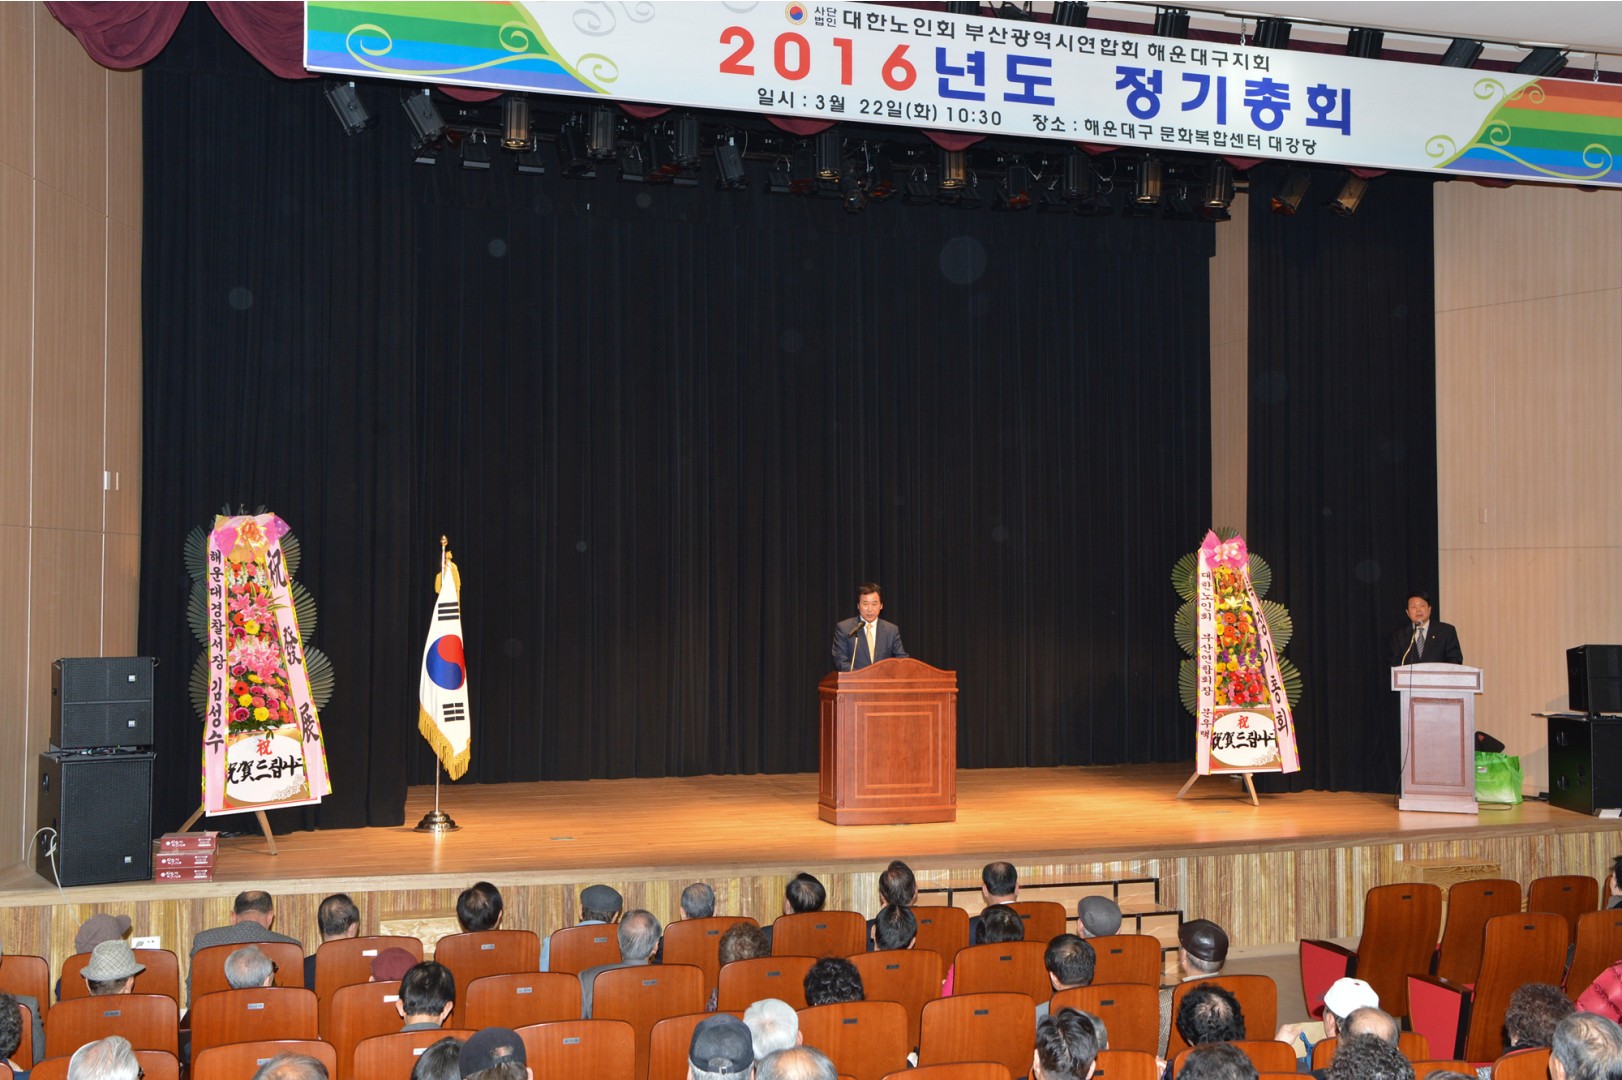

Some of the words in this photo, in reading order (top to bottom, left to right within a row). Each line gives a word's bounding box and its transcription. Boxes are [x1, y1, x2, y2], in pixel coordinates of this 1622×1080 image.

[814, 6, 837, 17] 사단
[814, 16, 836, 28] 법인
[843, 10, 956, 40] 대한노인회
[966, 23, 1138, 59] 부산광역시연합회
[1147, 42, 1270, 72] 해운대구지회
[719, 26, 1055, 107] 2016년도
[1115, 65, 1351, 136] 정기총회
[815, 94, 846, 113] 3월
[860, 99, 938, 121] 22일(화)
[946, 107, 1002, 126] 10:30
[1084, 118, 1153, 141] 해운대구
[1160, 126, 1261, 151] 문화복합센터
[1269, 136, 1317, 156] 대강당
[210, 549, 227, 670] 해운대경찰서장
[205, 677, 225, 754] 김성수
[1238, 715, 1249, 729] 祝
[256, 739, 273, 756] 祝
